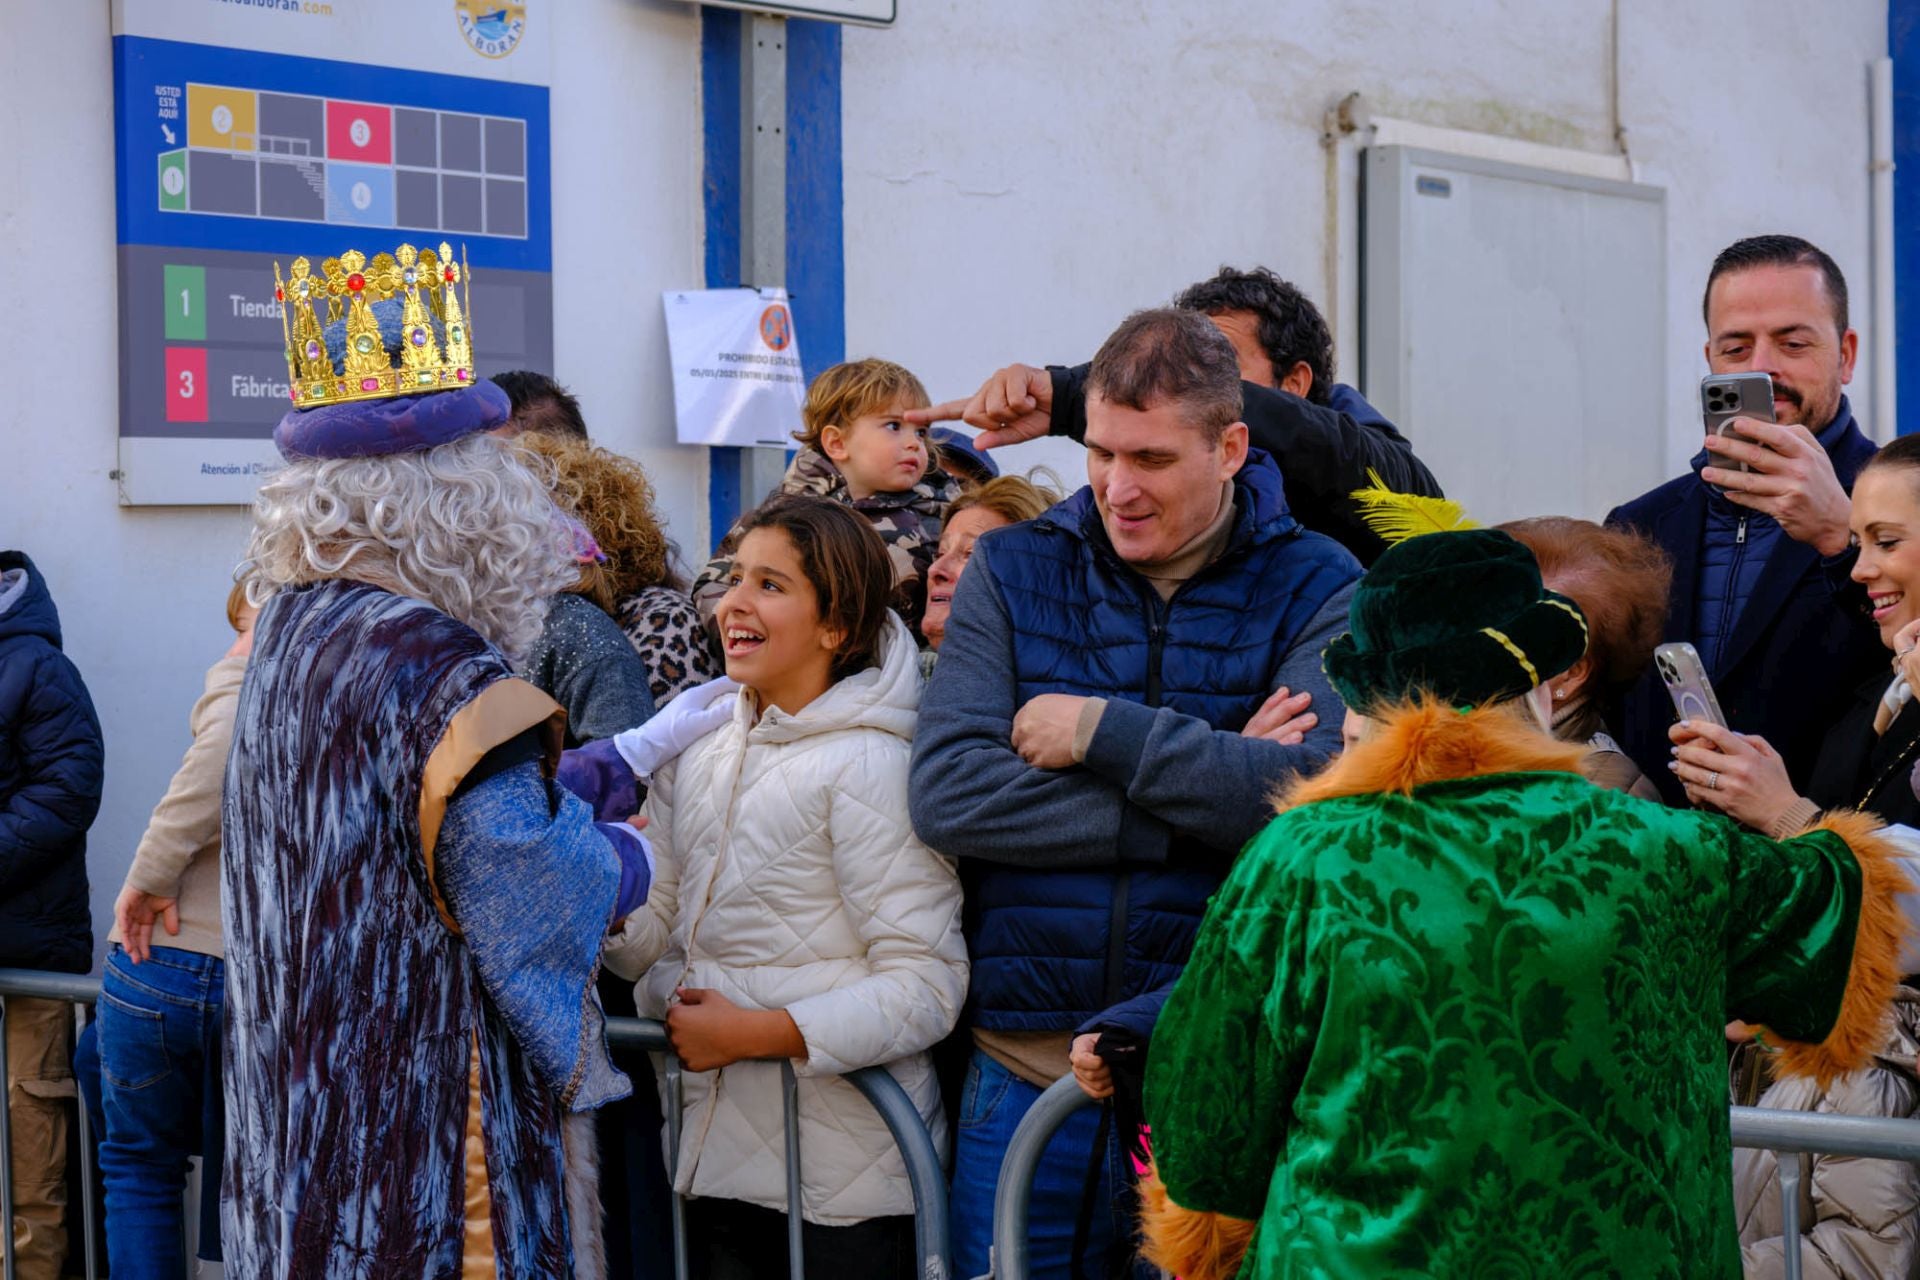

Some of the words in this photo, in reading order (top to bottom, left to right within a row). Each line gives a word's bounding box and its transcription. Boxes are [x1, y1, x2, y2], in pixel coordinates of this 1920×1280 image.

[181, 288, 189, 317] 1
[718, 352, 769, 365] PROHIBIDO
[179, 370, 194, 398] 3
[231, 375, 290, 398] Fábrica
[200, 462, 240, 475] Atención
[242, 463, 250, 474] al
